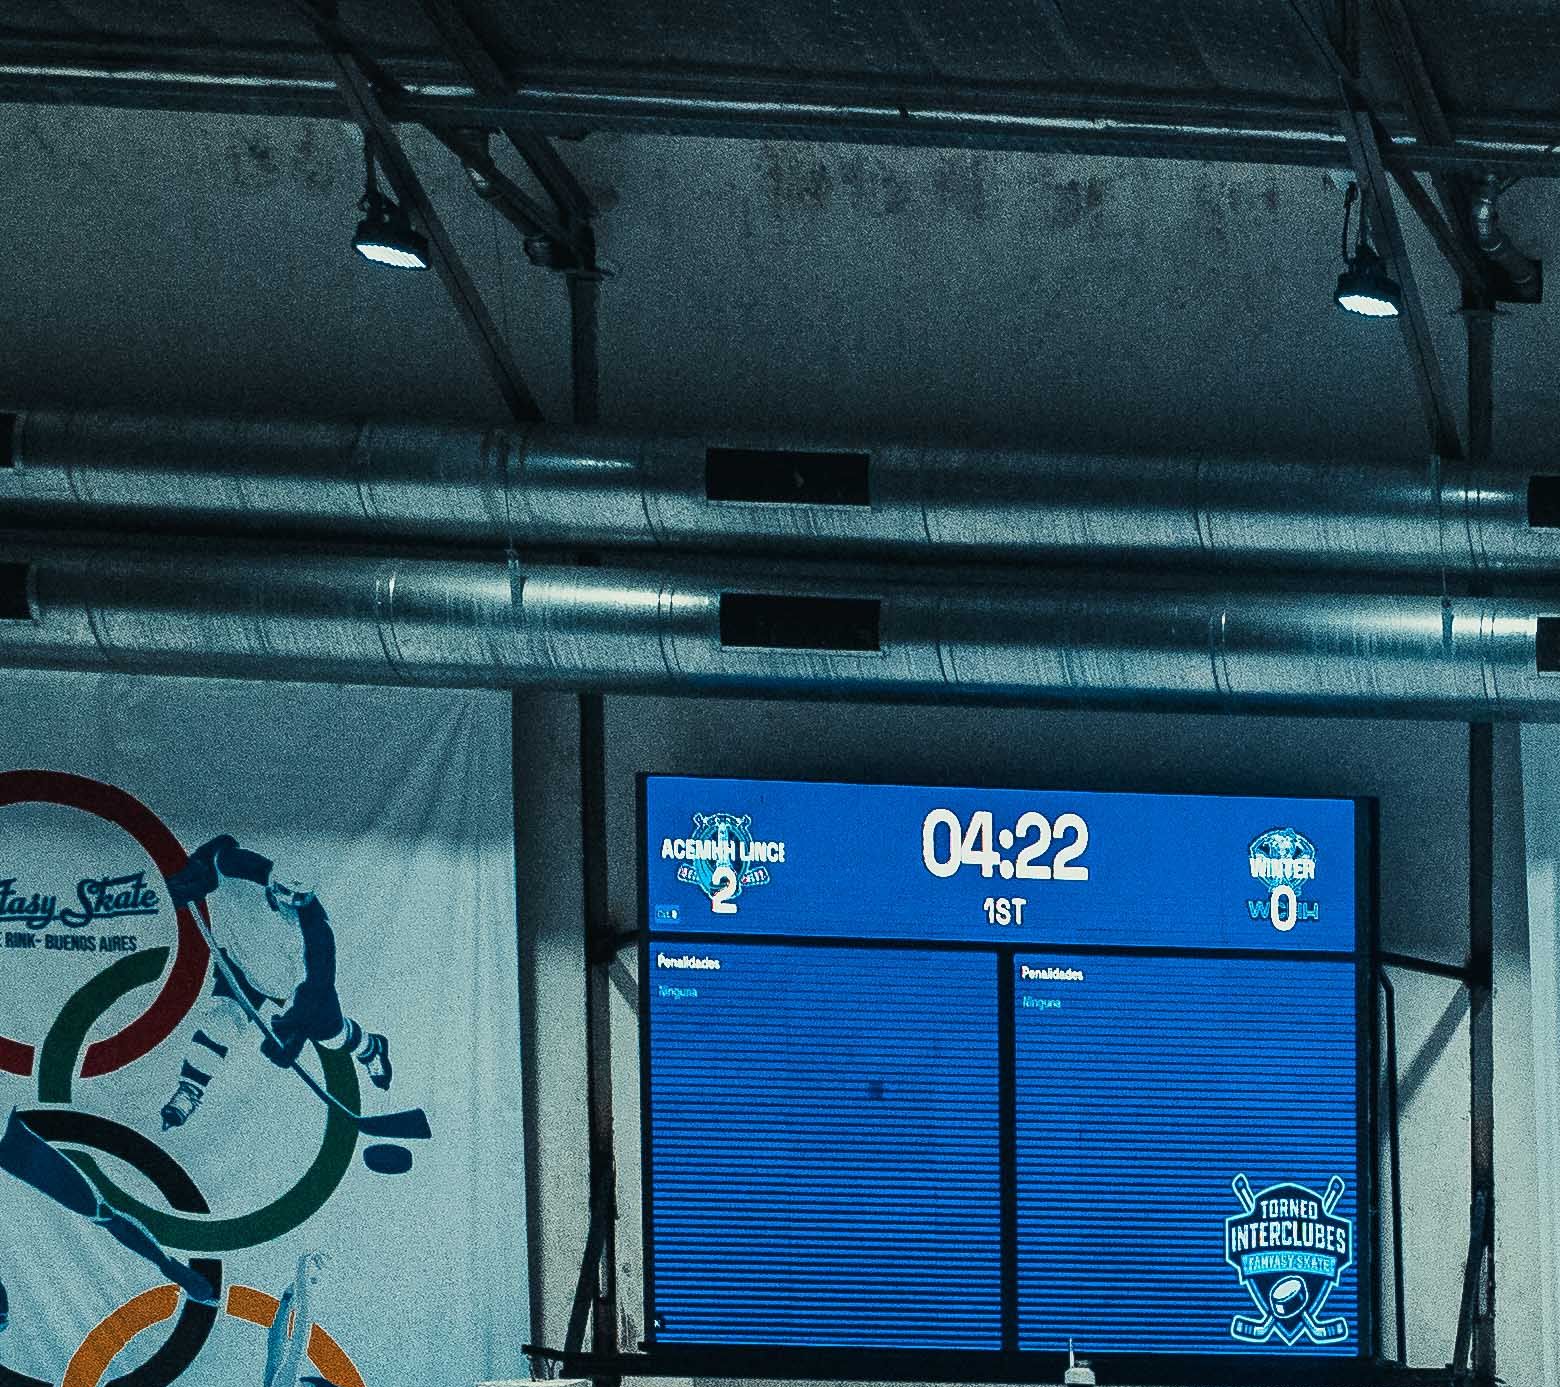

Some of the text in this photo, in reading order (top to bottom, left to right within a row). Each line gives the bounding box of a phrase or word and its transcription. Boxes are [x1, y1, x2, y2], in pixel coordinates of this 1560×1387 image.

[923, 808, 1089, 881] 04:22
[60, 869, 161, 928] Skate
[711, 866, 738, 914] 2
[983, 897, 1027, 926] 1ST
[1270, 885, 1297, 931] 0
[45, 933, 97, 951] BUENOS
[100, 934, 138, 951] AIRES
[657, 953, 721, 970] Penalidades
[1021, 965, 1084, 981] Penalidades
[1260, 1198, 1318, 1220] TORNEO
[1231, 1221, 1346, 1254] INTERCLUBES
